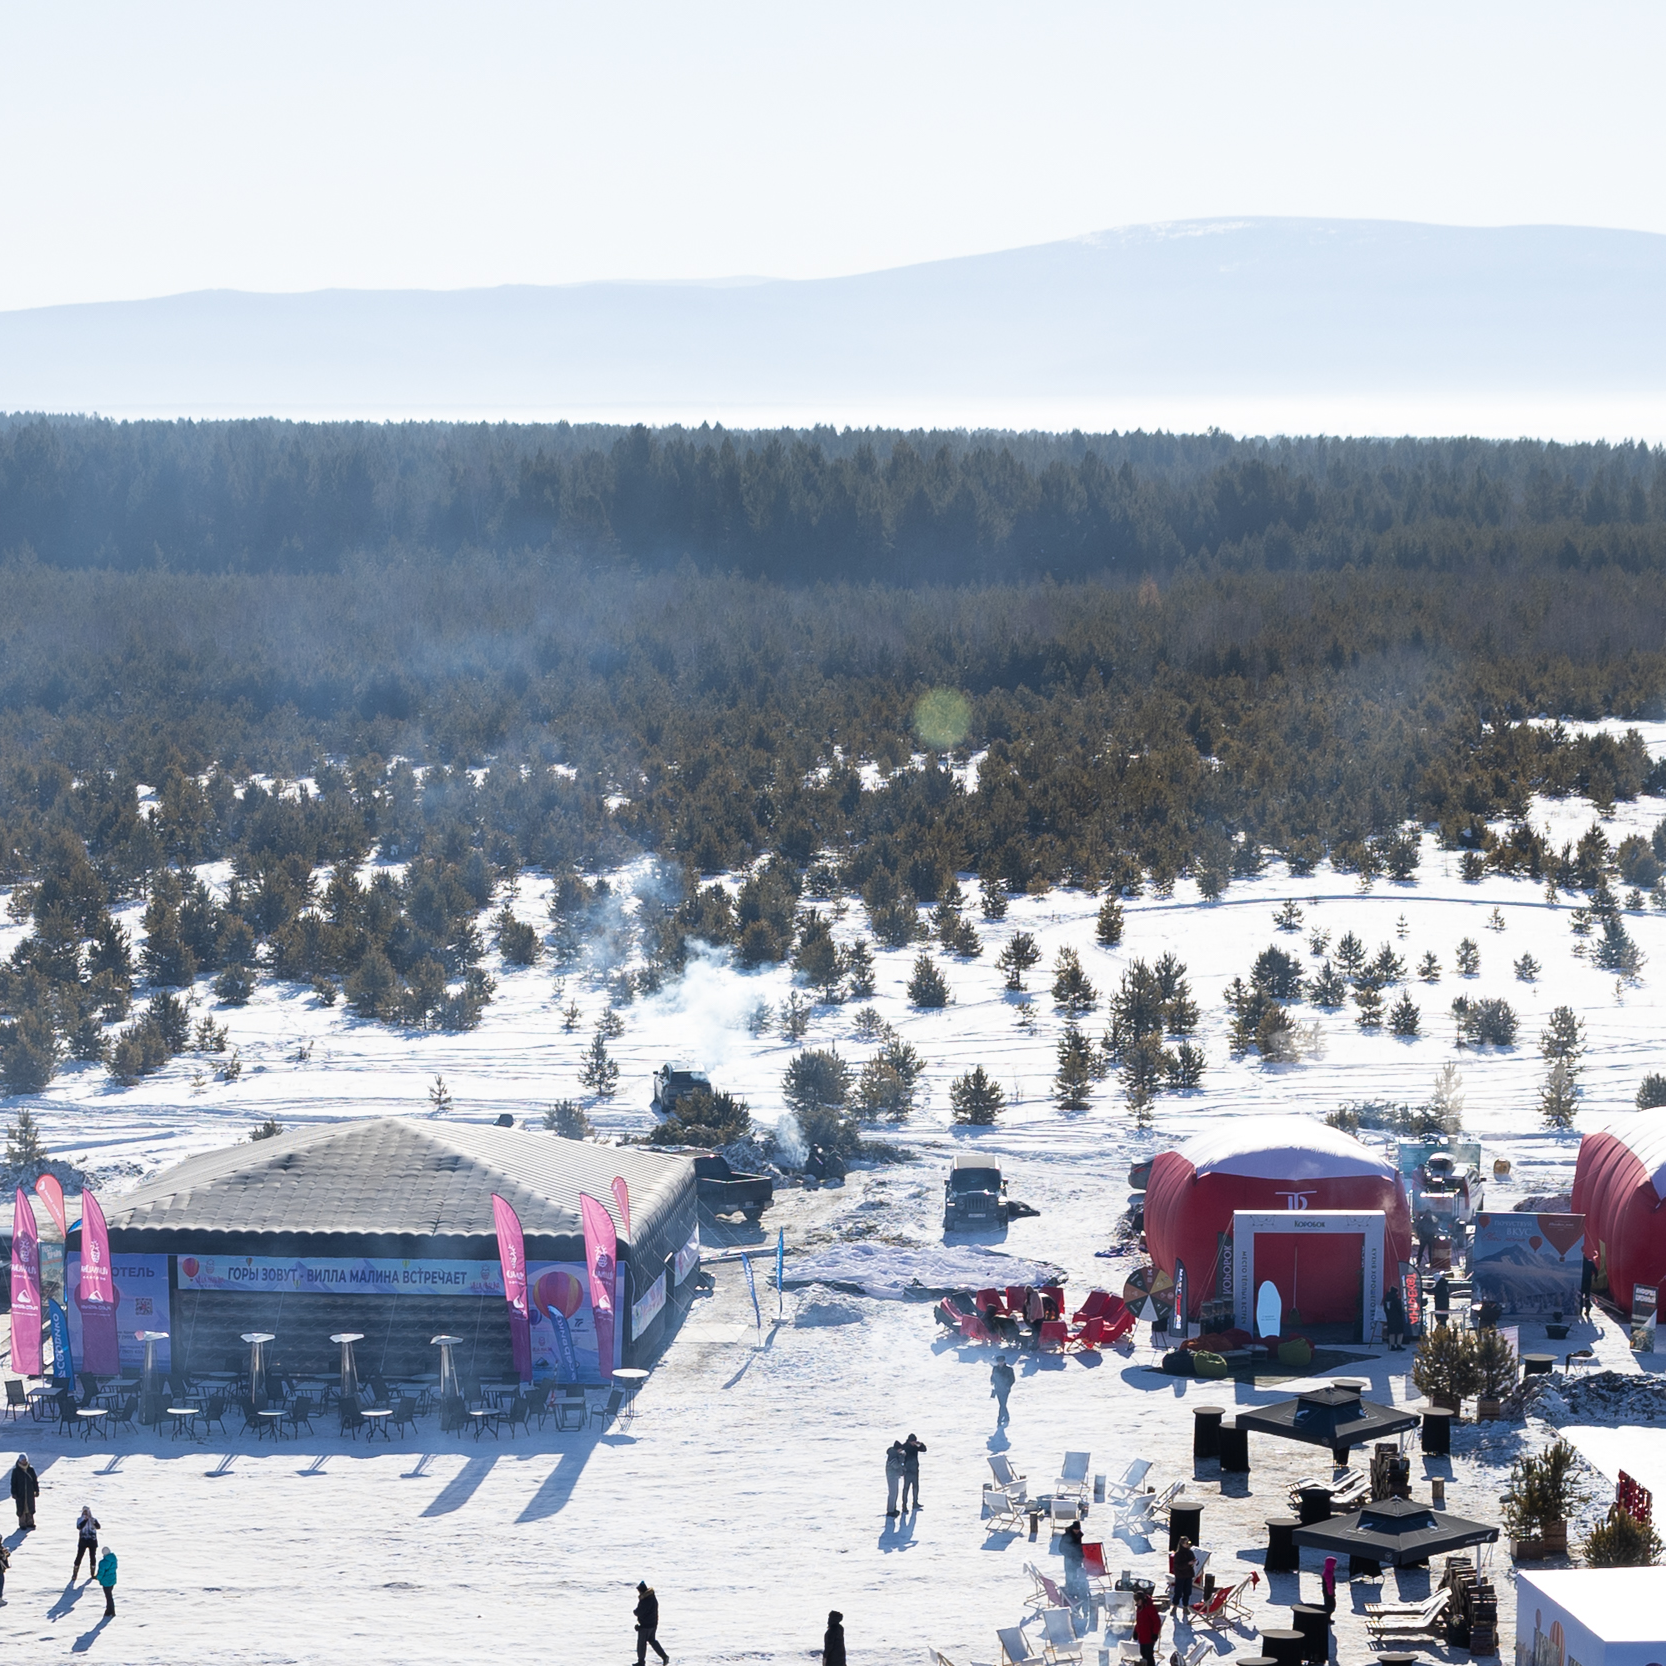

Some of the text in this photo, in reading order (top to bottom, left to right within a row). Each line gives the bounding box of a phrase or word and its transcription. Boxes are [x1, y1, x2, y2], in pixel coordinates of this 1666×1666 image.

[1506, 1227, 1533, 1236] ВКУС
[228, 1266, 259, 1282] ГОРЫ
[261, 1267, 298, 1282] ЗОВУТ
[307, 1268, 347, 1284] ВИЛЛА
[349, 1269, 400, 1285] МАЛИНА
[403, 1269, 467, 1285] ВСТРЕЧАЕТ
